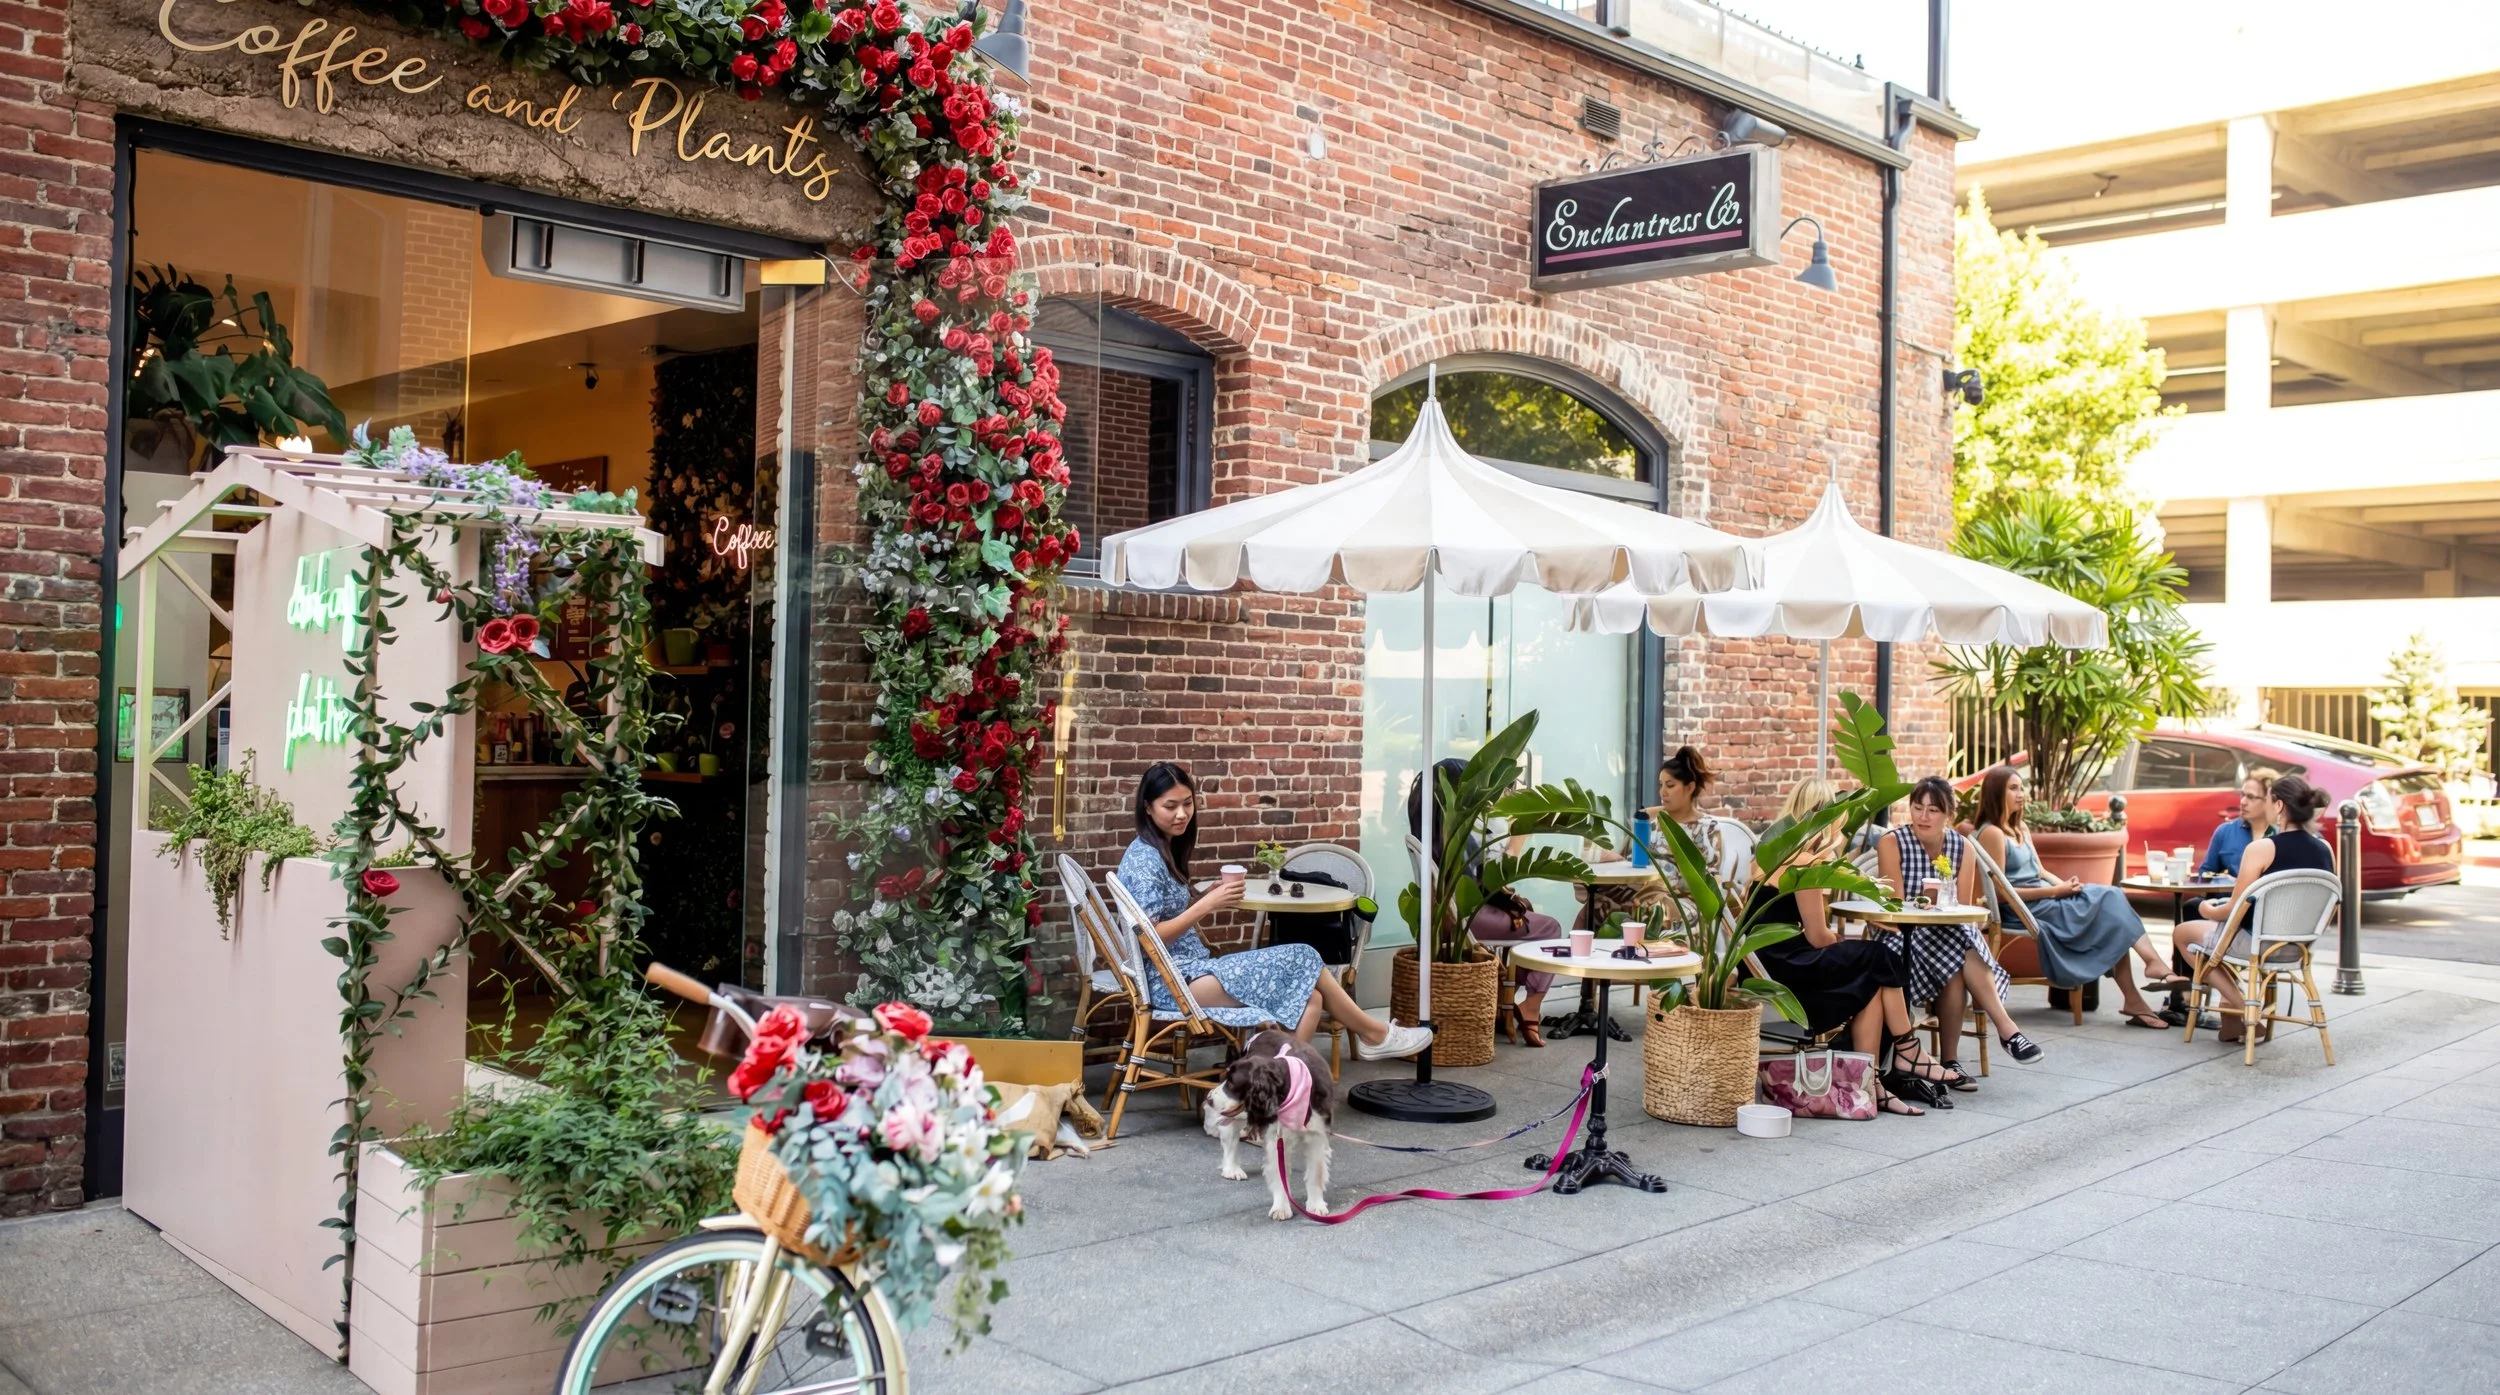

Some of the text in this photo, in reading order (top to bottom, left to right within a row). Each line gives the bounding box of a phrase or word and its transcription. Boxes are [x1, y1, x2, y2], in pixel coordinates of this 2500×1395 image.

[159, 0, 839, 201] Coffee and Plants
[1545, 182, 1744, 251] Enchantress Co.
[713, 515, 775, 569] Coffee
